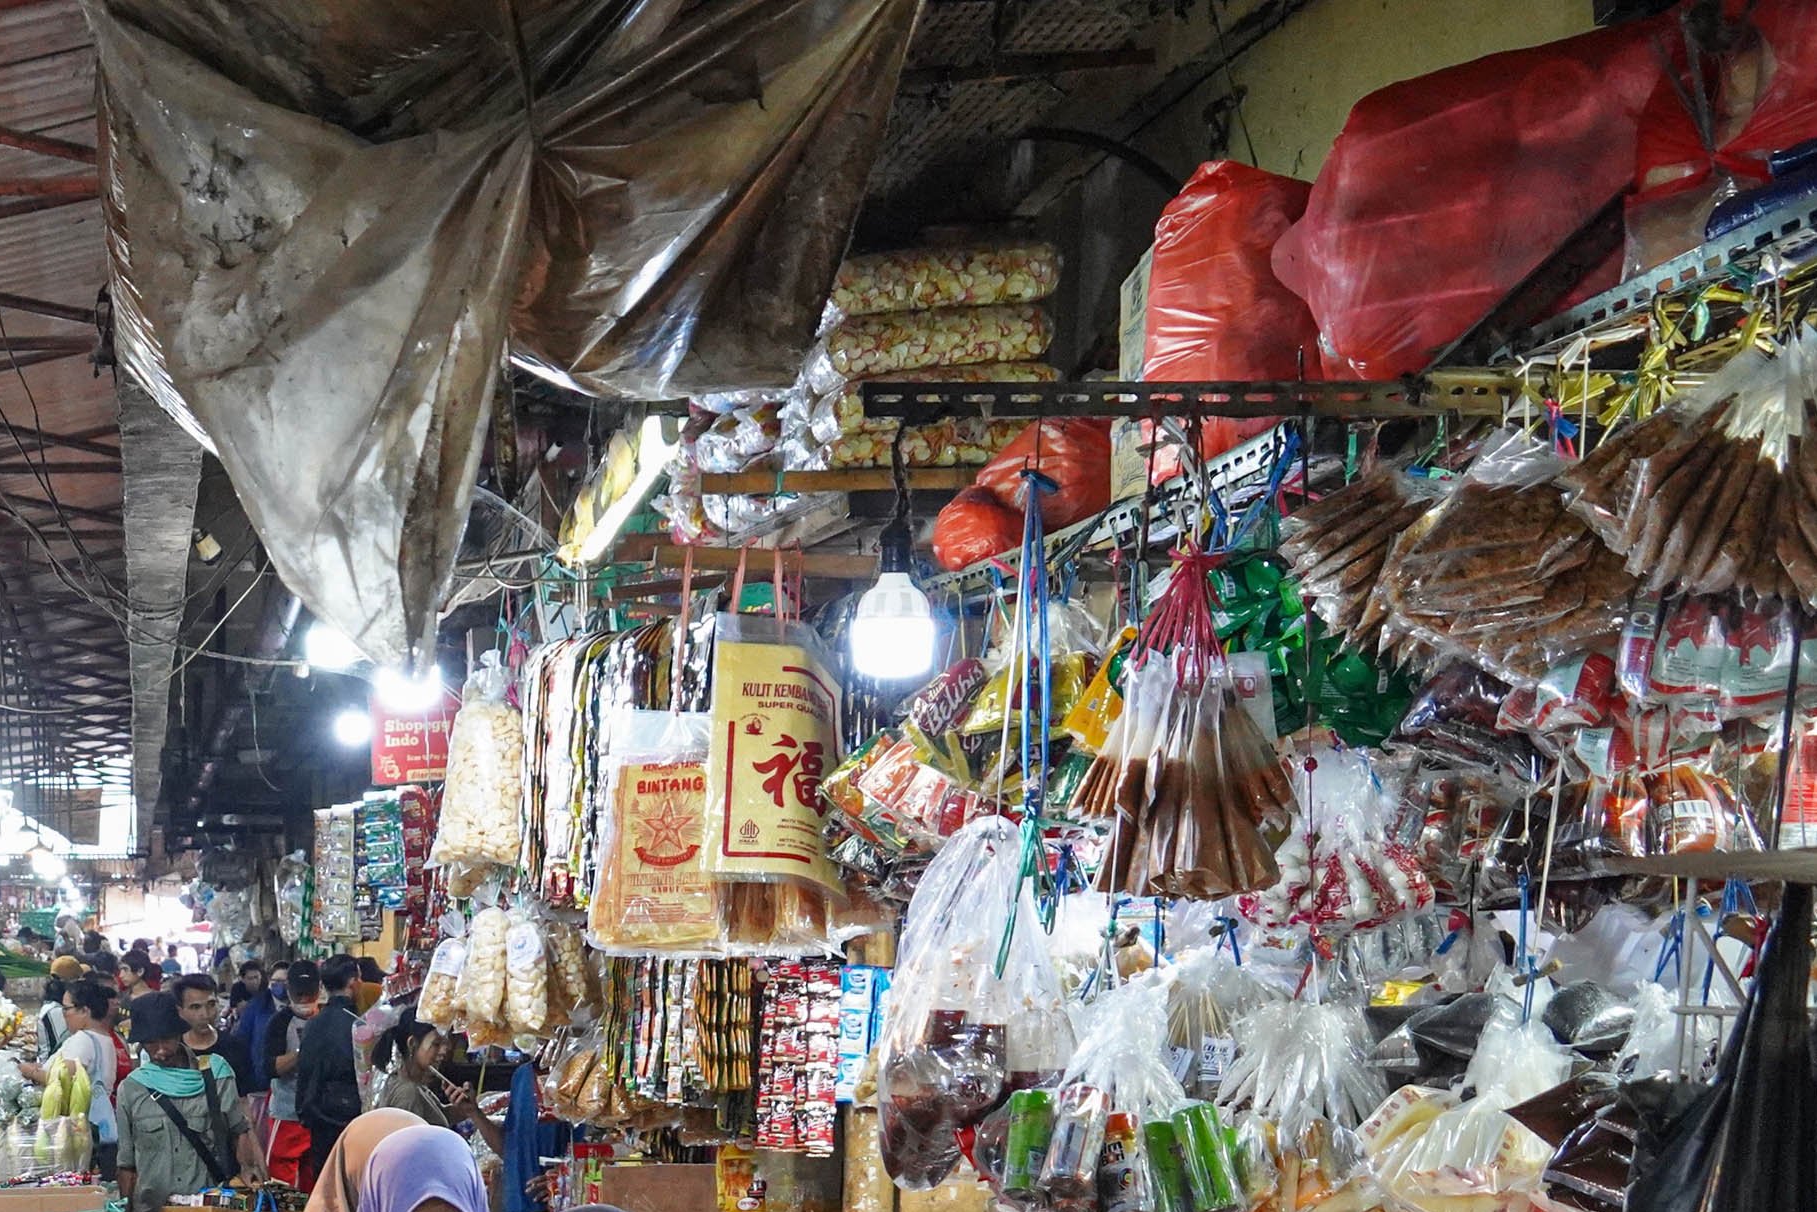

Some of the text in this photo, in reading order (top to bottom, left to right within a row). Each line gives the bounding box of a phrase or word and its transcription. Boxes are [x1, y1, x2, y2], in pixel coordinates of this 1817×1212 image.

[742, 682, 773, 697] KULIT
[758, 700, 793, 709] SUPER
[927, 663, 984, 737] Belibis
[384, 733, 420, 748] Indo
[753, 733, 827, 818] 福
[637, 775, 705, 795] BINTANG
